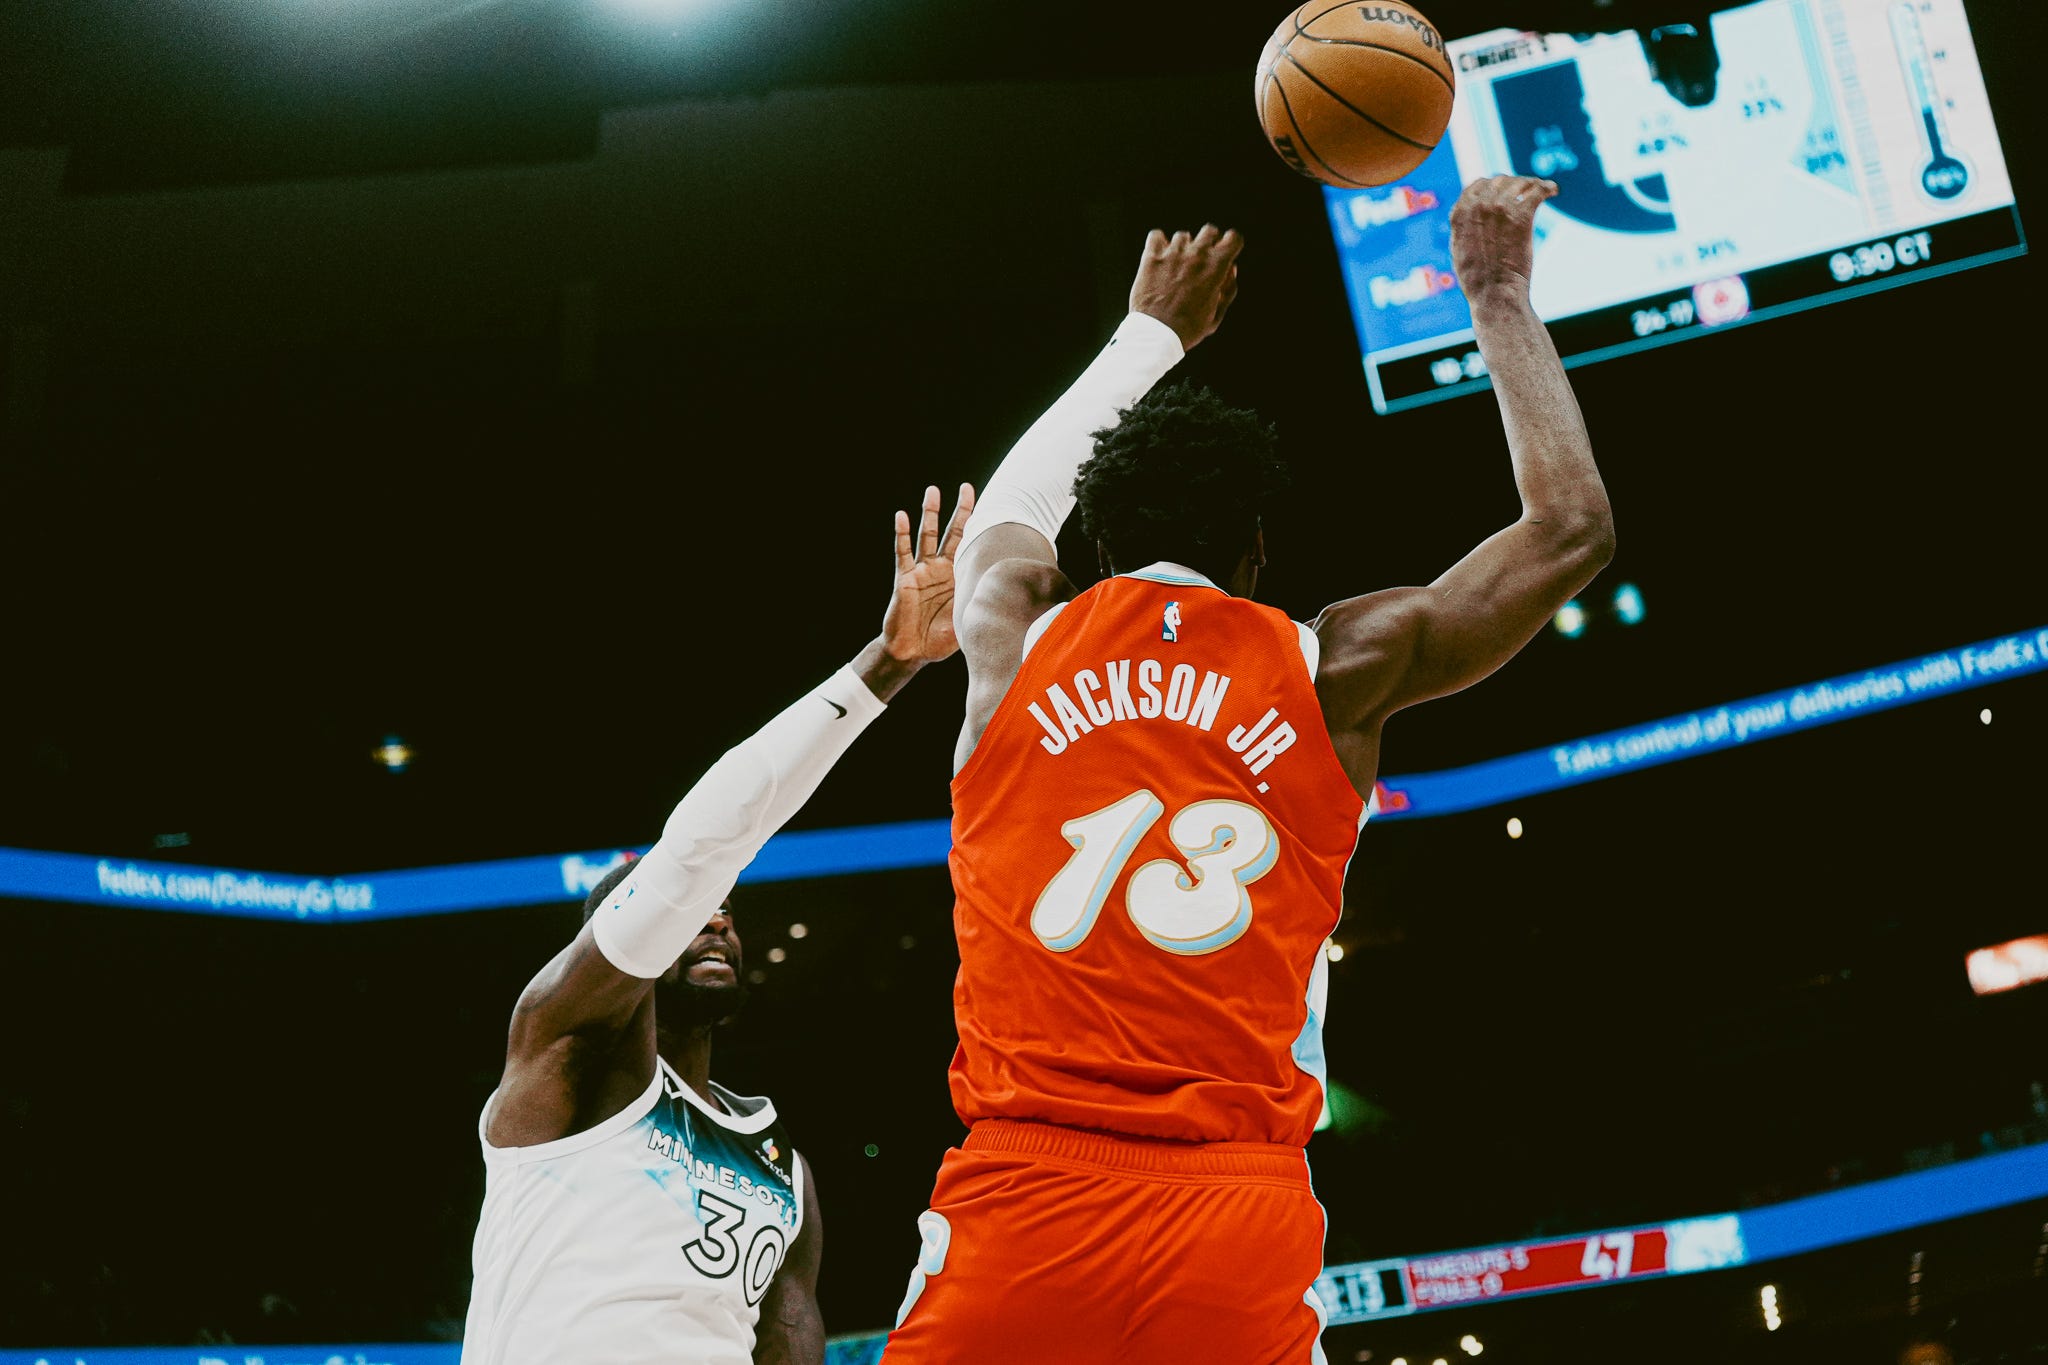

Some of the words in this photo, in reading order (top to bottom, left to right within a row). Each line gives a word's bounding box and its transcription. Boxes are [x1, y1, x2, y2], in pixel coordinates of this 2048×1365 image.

[1828, 241, 1895, 282] 9:30
[1895, 231, 1932, 267] CT
[1027, 659, 1231, 756] JACKSON
[1226, 707, 1297, 794] JR.
[1554, 741, 1612, 778] Take
[1614, 713, 1700, 763] control
[1702, 706, 1730, 742] of
[1731, 699, 1786, 742] your
[1789, 672, 1905, 721] deliveries
[1906, 653, 1960, 692] with
[1961, 637, 2036, 678] FedEx
[1030, 789, 1280, 955] 13
[648, 1127, 795, 1228] MINNESOTA
[681, 1189, 785, 1308] 30
[1580, 1230, 1634, 1279] 47
